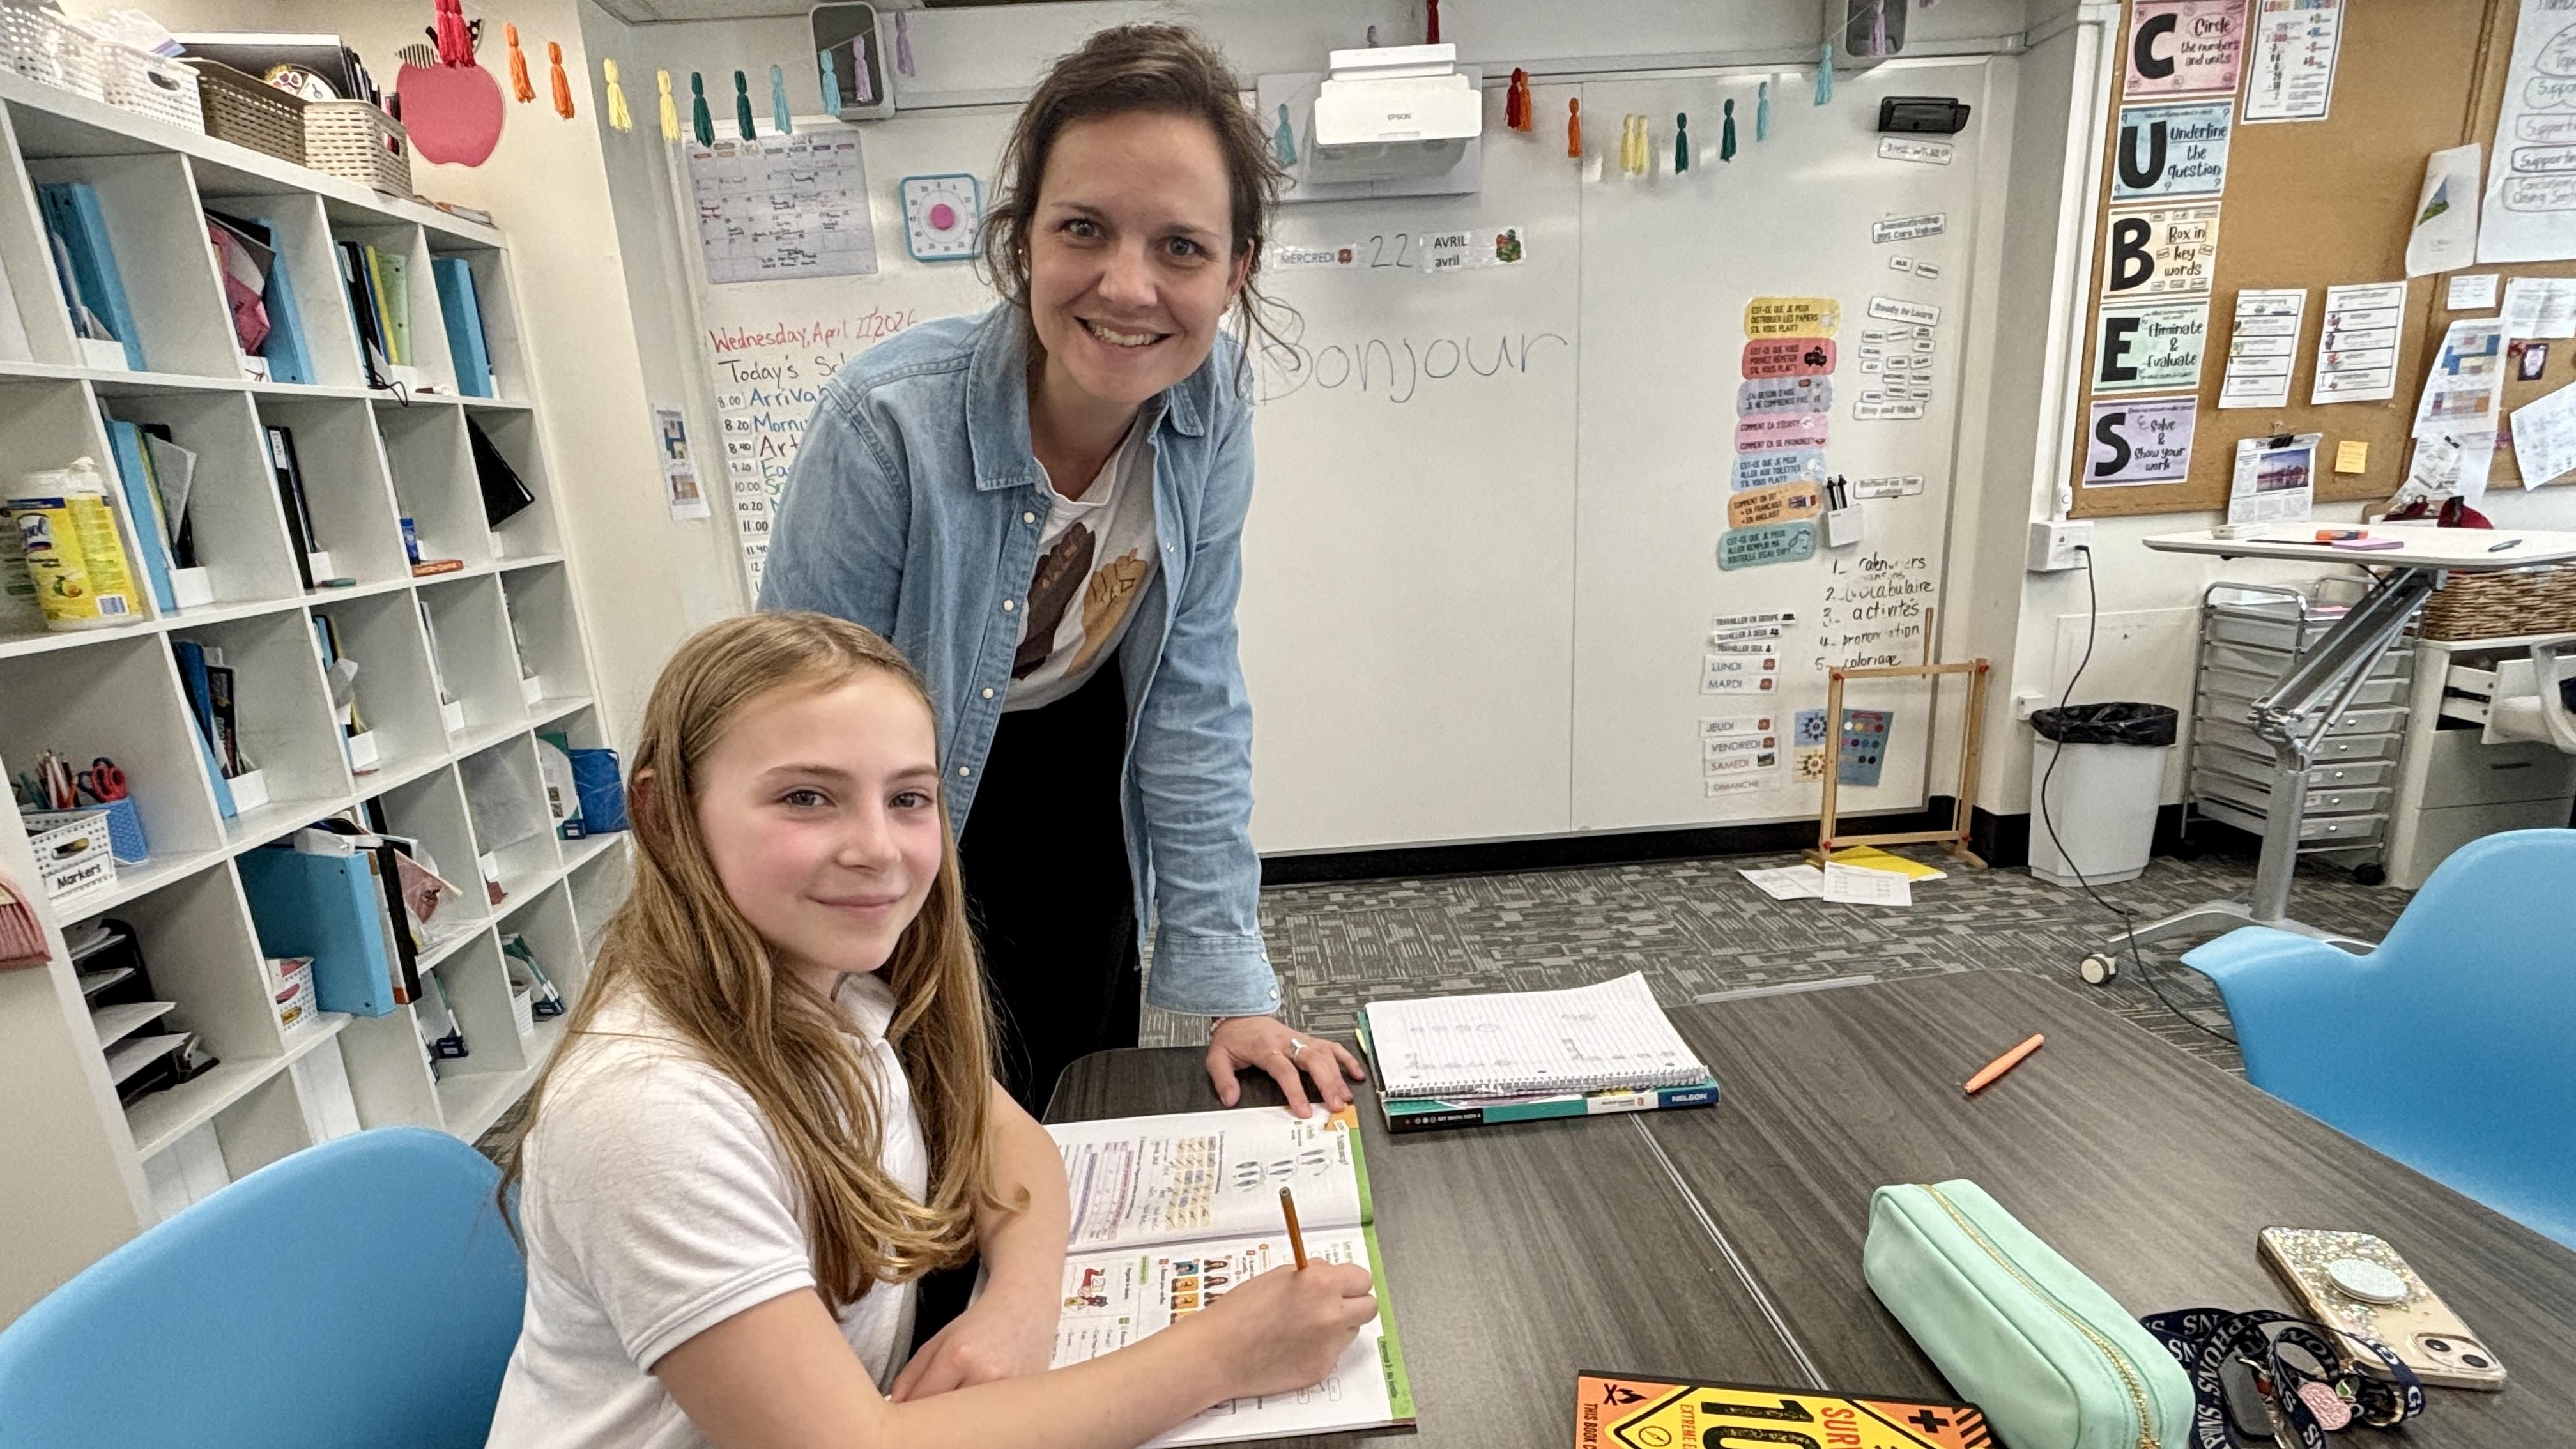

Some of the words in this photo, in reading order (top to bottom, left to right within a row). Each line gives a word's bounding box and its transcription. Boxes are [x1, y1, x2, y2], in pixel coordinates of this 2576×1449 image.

[2195, 17, 2230, 36] Circle
[2134, 13, 2177, 79] C
[2181, 41, 2196, 53] the
[2198, 38, 2240, 52] numbers
[2186, 53, 2204, 66] and
[2205, 54, 2232, 65] units
[2170, 123, 2228, 140] Underline
[2119, 120, 2168, 189] U
[2187, 144, 2207, 161] the
[2168, 160, 2221, 180] question
[1434, 234, 1468, 249] AVRIL
[2168, 226, 2191, 243] Box
[2194, 226, 2207, 239] in
[1280, 252, 1335, 265] MERCREDI
[1369, 233, 1413, 268] 22
[2110, 217, 2155, 292] B
[2174, 245, 2196, 262] key
[1435, 255, 1460, 268] avril
[2164, 261, 2203, 277] words
[813, 319, 847, 348] April
[2148, 320, 2204, 338] Eliminate
[1260, 297, 1568, 406] Bonjour
[2101, 318, 2140, 383] E
[2170, 337, 2179, 352] &
[2147, 351, 2198, 368] Evaluate
[717, 354, 799, 389] Today's
[815, 352, 847, 377] Sc
[2150, 418, 2176, 433] Solve
[759, 434, 799, 457] Art
[2094, 412, 2132, 477] S
[2158, 432, 2165, 445] &
[2134, 447, 2160, 461] Show
[2161, 448, 2186, 459] your
[2145, 457, 2172, 471] work
[1712, 662, 1742, 672] LUNDI
[1708, 679, 1742, 689] MARDI
[1706, 721, 1734, 733] JEUDI
[1711, 740, 1761, 753] VENDREDI
[1711, 758, 1749, 772] SAMEDI
[1713, 780, 1759, 792] DIMANCHE
[57, 864, 102, 890] Markers
[1671, 1092, 1708, 1103] NELSON
[1583, 1403, 1598, 1422] THIS
[1680, 1404, 1698, 1444] EXTREME
[1583, 1422, 1598, 1444] BOOK
